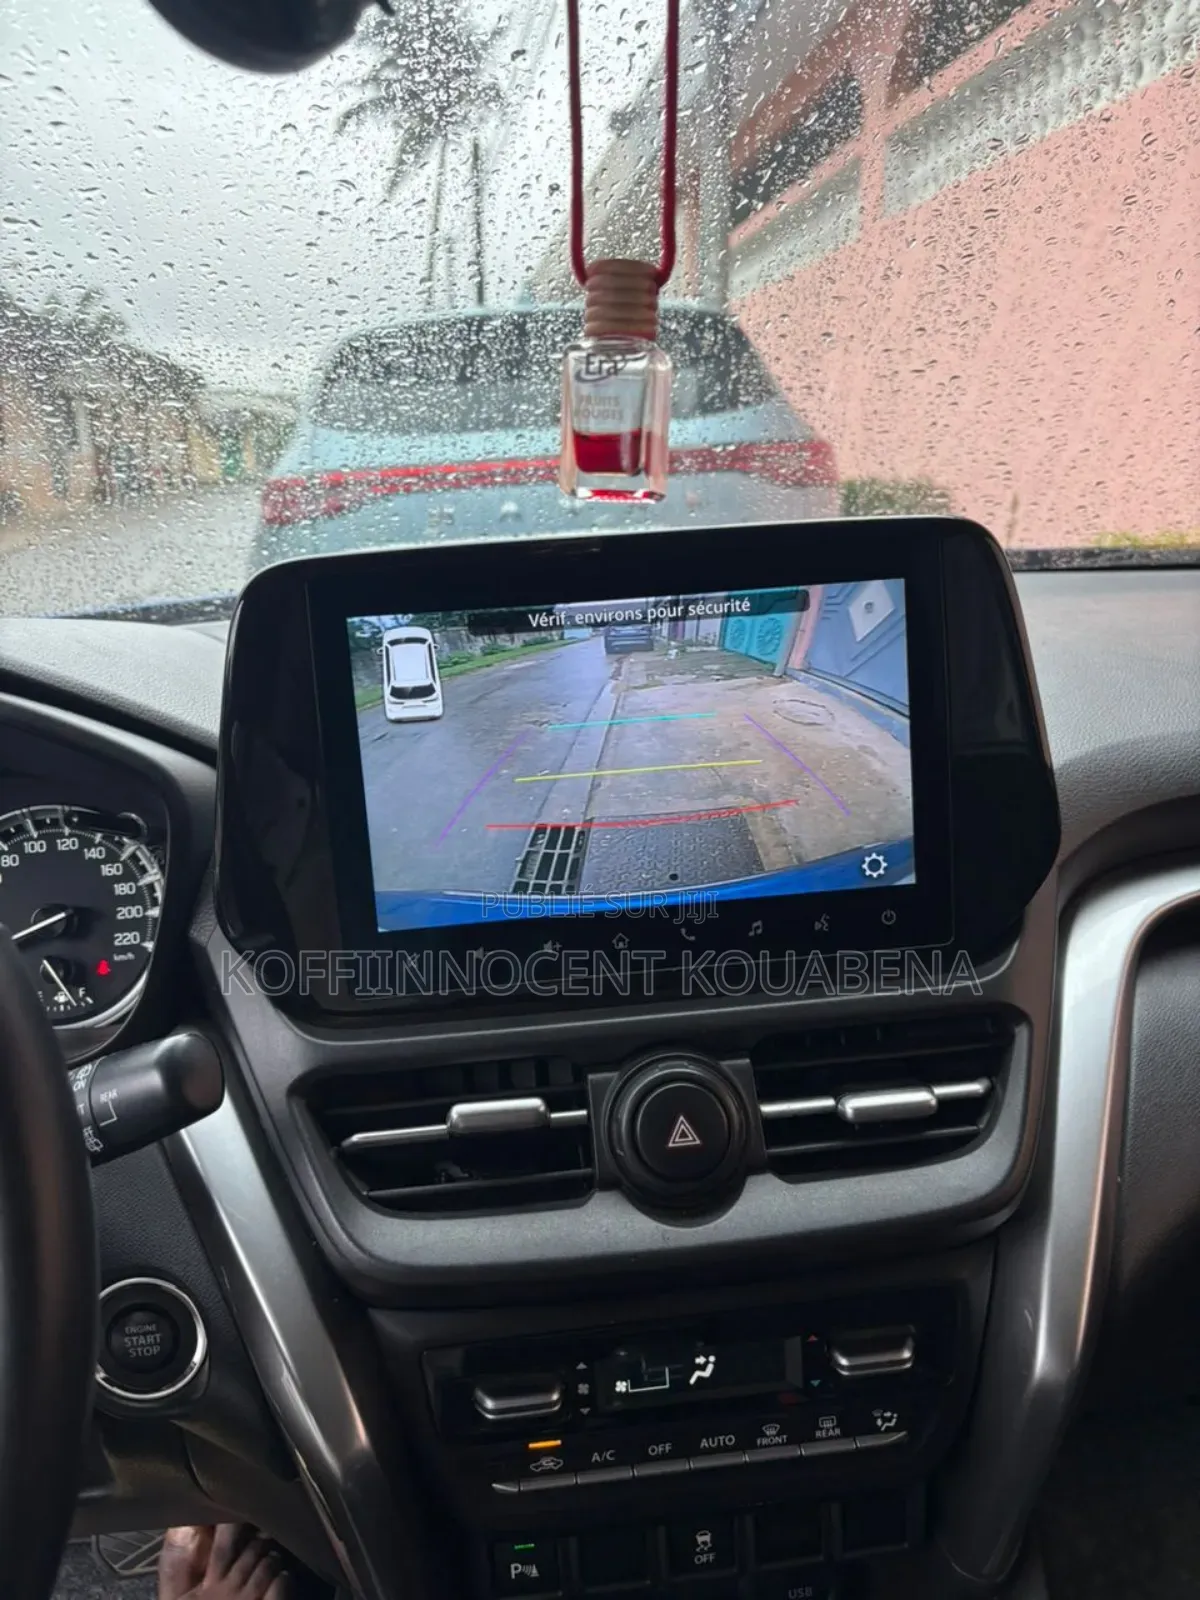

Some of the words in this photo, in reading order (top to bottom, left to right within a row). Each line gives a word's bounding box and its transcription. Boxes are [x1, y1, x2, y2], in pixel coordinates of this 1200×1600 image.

[528, 611, 571, 628] Vérif.
[575, 608, 643, 624] environs
[647, 604, 683, 622] pour
[688, 597, 751, 616] sécurité
[24, 840, 47, 853] 100
[56, 838, 79, 851] 120
[84, 846, 106, 860] 140
[0, 854, 20, 867] 80
[100, 863, 123, 876] 160
[114, 882, 136, 895] 180
[116, 906, 144, 919] 200
[114, 932, 141, 945] 220
[124, 1334, 161, 1347] START
[129, 1345, 160, 1358] STOP
[815, 1427, 841, 1438] REAR
[700, 1434, 736, 1448] AUTO
[757, 1435, 788, 1446] FRONT
[648, 1443, 673, 1456] OFF
[592, 1450, 615, 1463] A/C
[694, 1553, 716, 1565] OFF
[788, 1586, 813, 1600] USB
